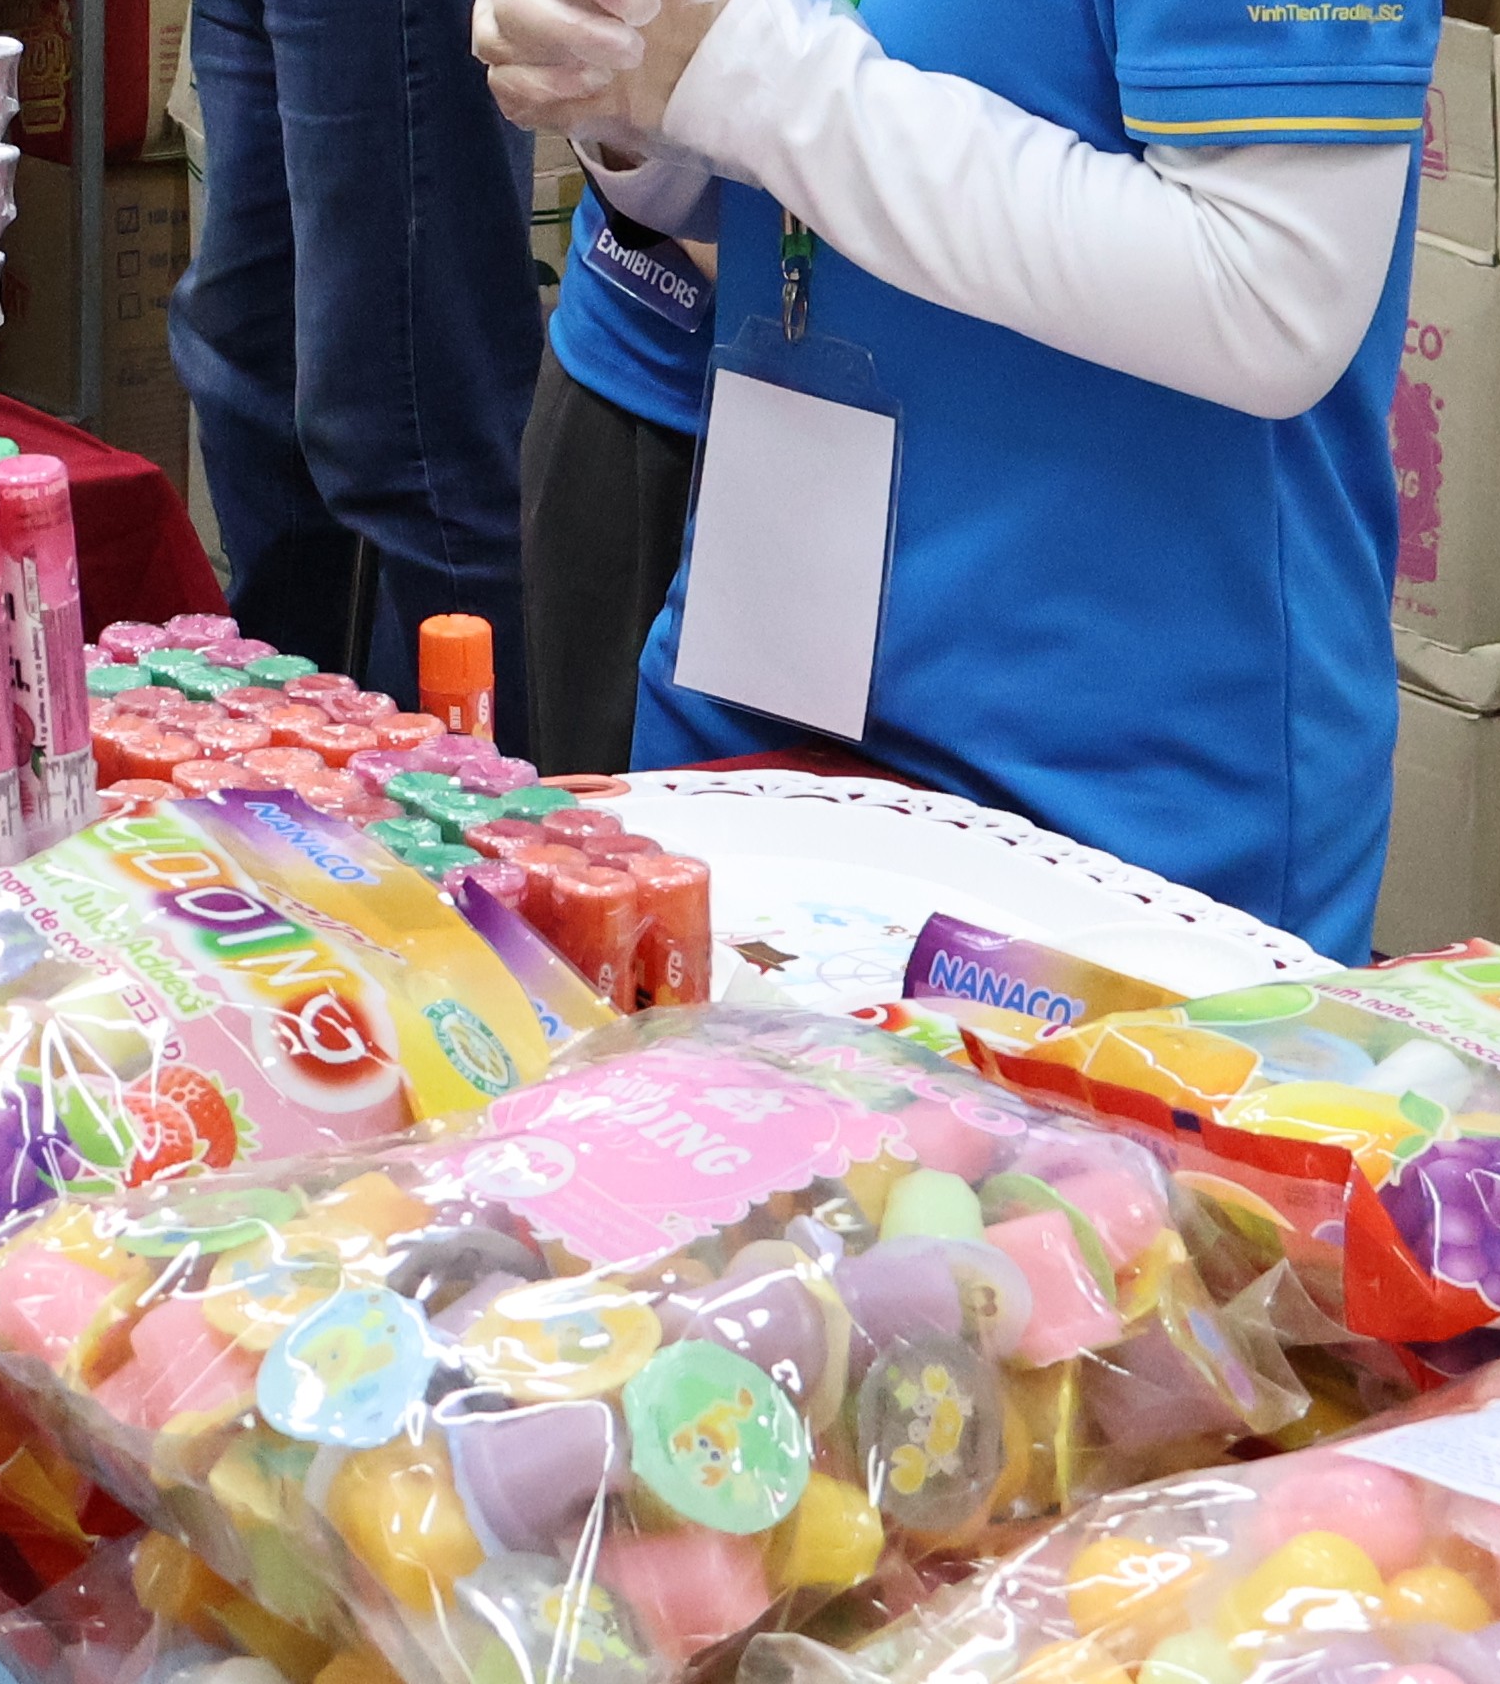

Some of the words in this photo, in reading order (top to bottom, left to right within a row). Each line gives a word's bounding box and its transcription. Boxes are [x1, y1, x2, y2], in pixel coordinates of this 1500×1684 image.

[243, 800, 381, 886] NANACO
[928, 950, 1076, 1030] NANACO
[1361, 995, 1416, 1027] nata
